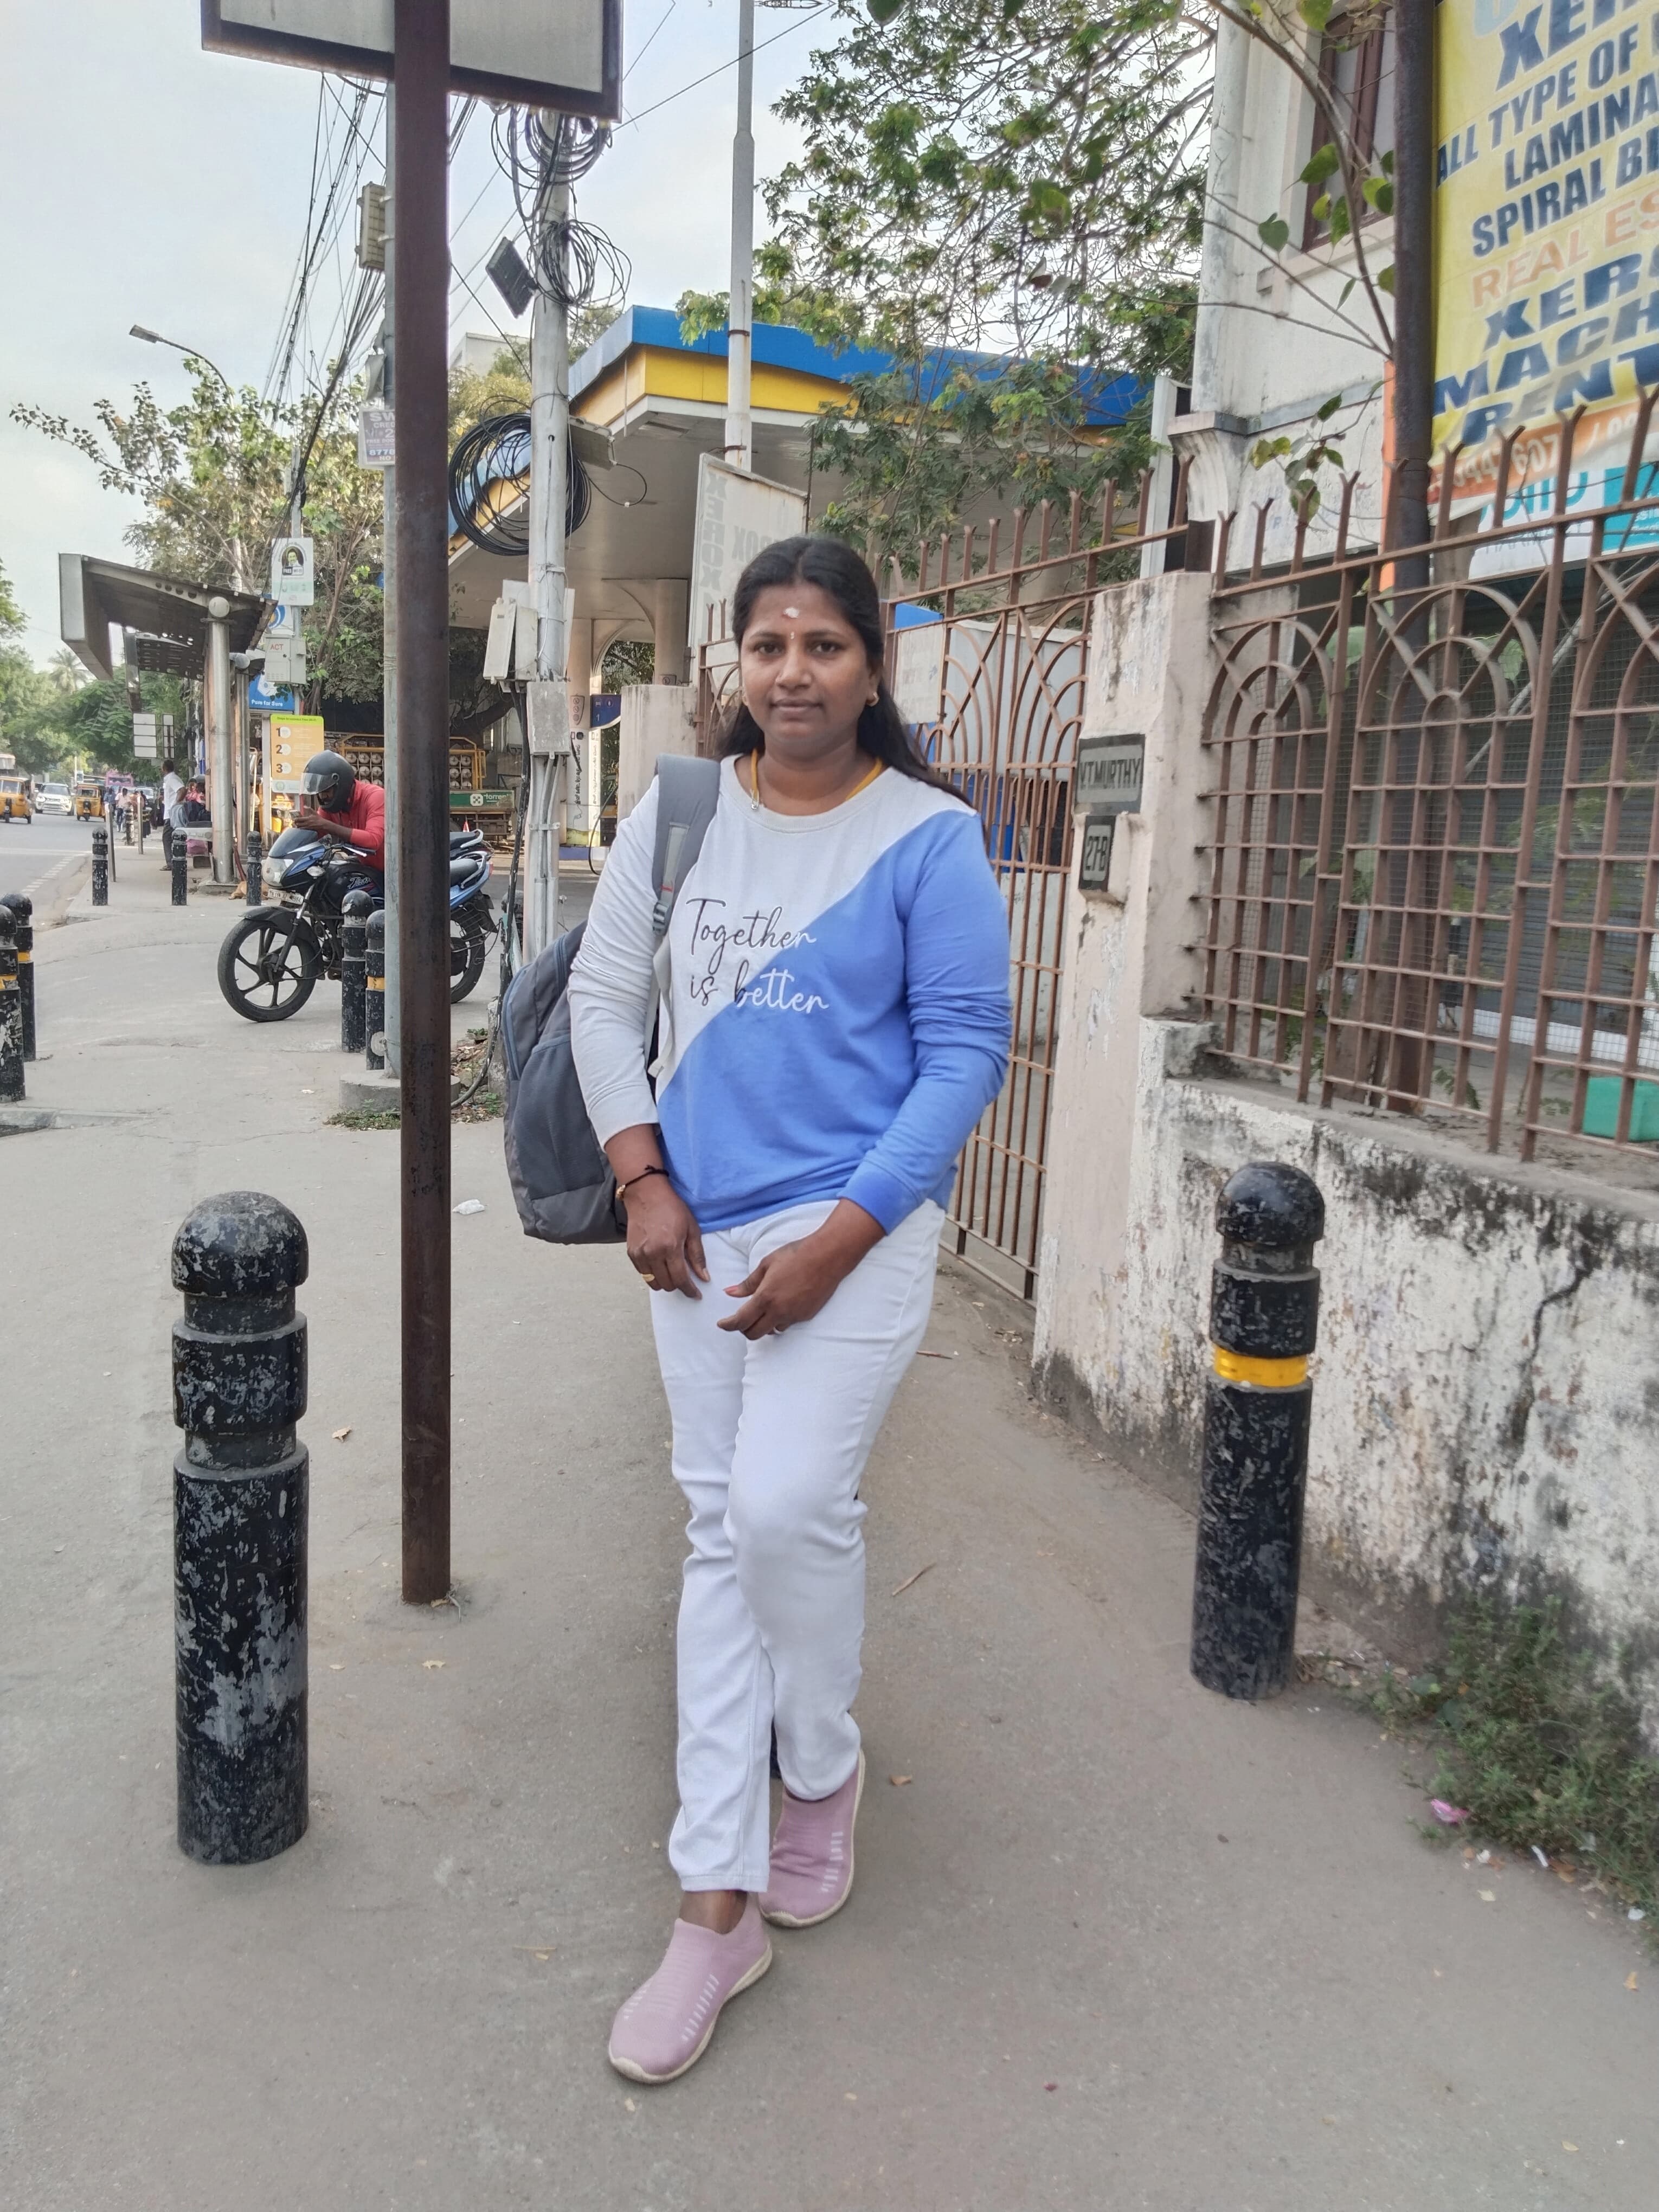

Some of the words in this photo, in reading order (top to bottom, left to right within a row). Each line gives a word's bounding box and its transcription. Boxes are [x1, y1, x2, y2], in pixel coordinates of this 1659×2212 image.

[1436, 124, 1479, 188] ALL
[1488, 60, 1577, 150] TYPE
[1588, 22, 1639, 89] OF
[1505, 72, 1659, 191] LAMINA
[1472, 158, 1606, 258] SPIRAL
[1472, 229, 1589, 308] REAL
[1433, 291, 1659, 416] MACH
[275, 728, 280, 737] 1
[275, 744, 282, 754] 2
[276, 763, 283, 773] 3
[686, 897, 816, 975] Together
[690, 975, 718, 1006] is
[734, 959, 829, 1013] better
